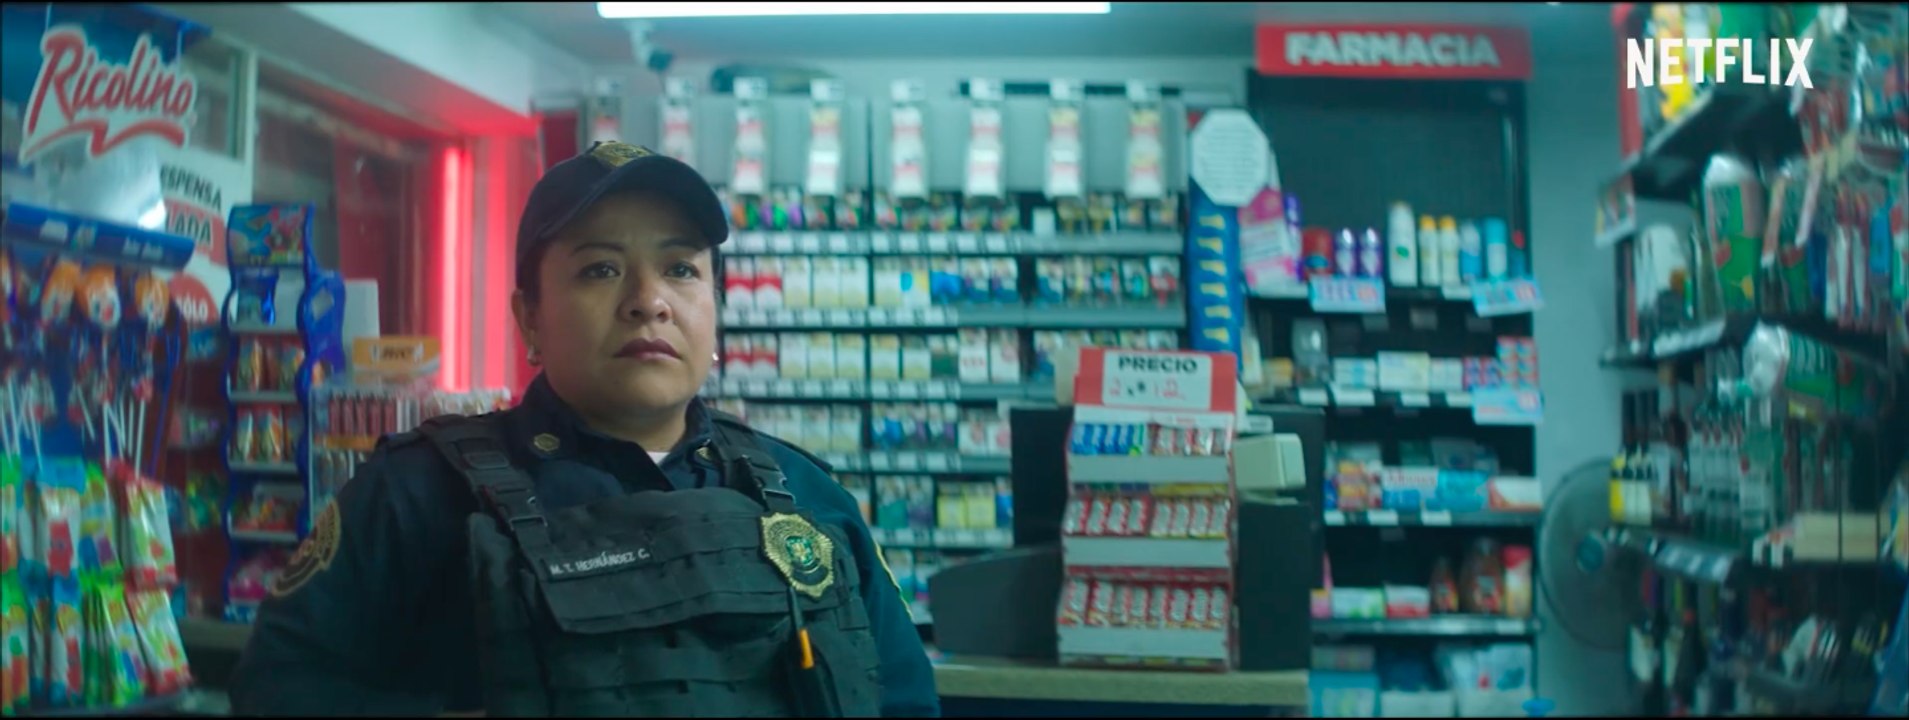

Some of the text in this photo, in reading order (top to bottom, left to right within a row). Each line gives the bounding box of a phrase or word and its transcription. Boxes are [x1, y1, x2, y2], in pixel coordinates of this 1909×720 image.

[1285, 31, 1500, 67] FARMACIA
[28, 30, 193, 136] Ricolino
[1118, 355, 1198, 374] PRECIO
[637, 547, 651, 560] C.
